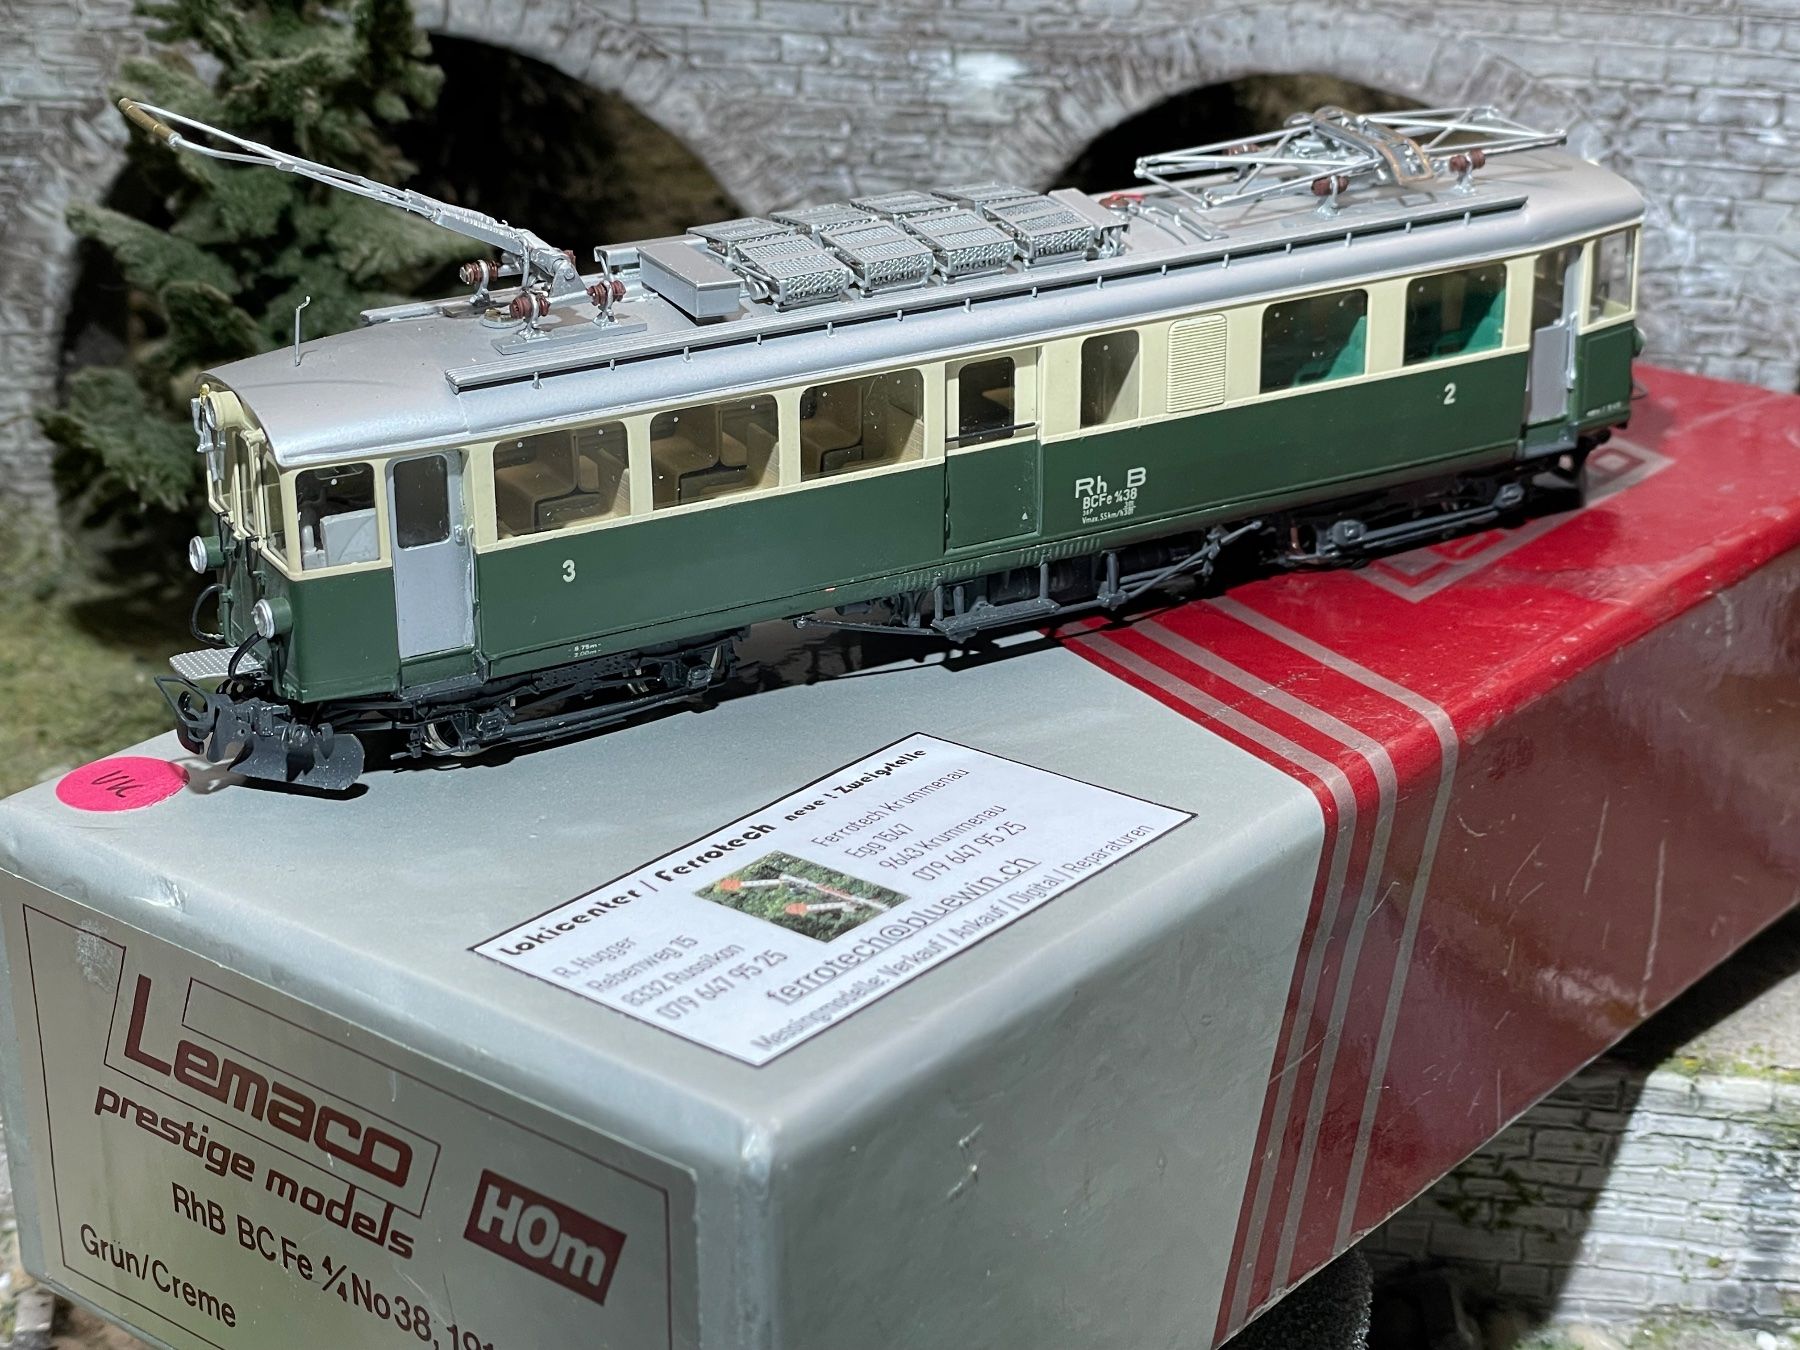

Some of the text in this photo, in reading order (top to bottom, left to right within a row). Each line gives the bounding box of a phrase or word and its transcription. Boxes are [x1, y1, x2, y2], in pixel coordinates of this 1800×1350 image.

[1444, 383, 1456, 405] 2
[1075, 467, 1147, 499] Rh B
[562, 559, 576, 583] 3
[785, 801, 825, 821] neue
[833, 751, 926, 793] Zweigstelle
[811, 770, 970, 847] Ferrotech Krummenau
[844, 823, 913, 858] Egg 1547
[879, 806, 1007, 869] 9643 Krummenau
[912, 822, 1026, 880] 079 647 95 25
[766, 858, 1041, 1004] ferrotech@bluewin.ch
[877, 938, 948, 977] Verkauf
[948, 904, 1008, 939] Ankauf
[1007, 875, 1065, 905] Digital
[1061, 826, 1154, 873] Reparaturen
[570, 937, 636, 970] Hugger
[669, 935, 698, 949] 15
[655, 950, 788, 1020] 079 647 95 25
[124, 974, 413, 1187] Lemaco
[94, 1086, 415, 1260] prestige models
[80, 1223, 237, 1328] Grün/Creme
[172, 1181, 227, 1236] RhB
[446, 1323, 494, 1350] 19
